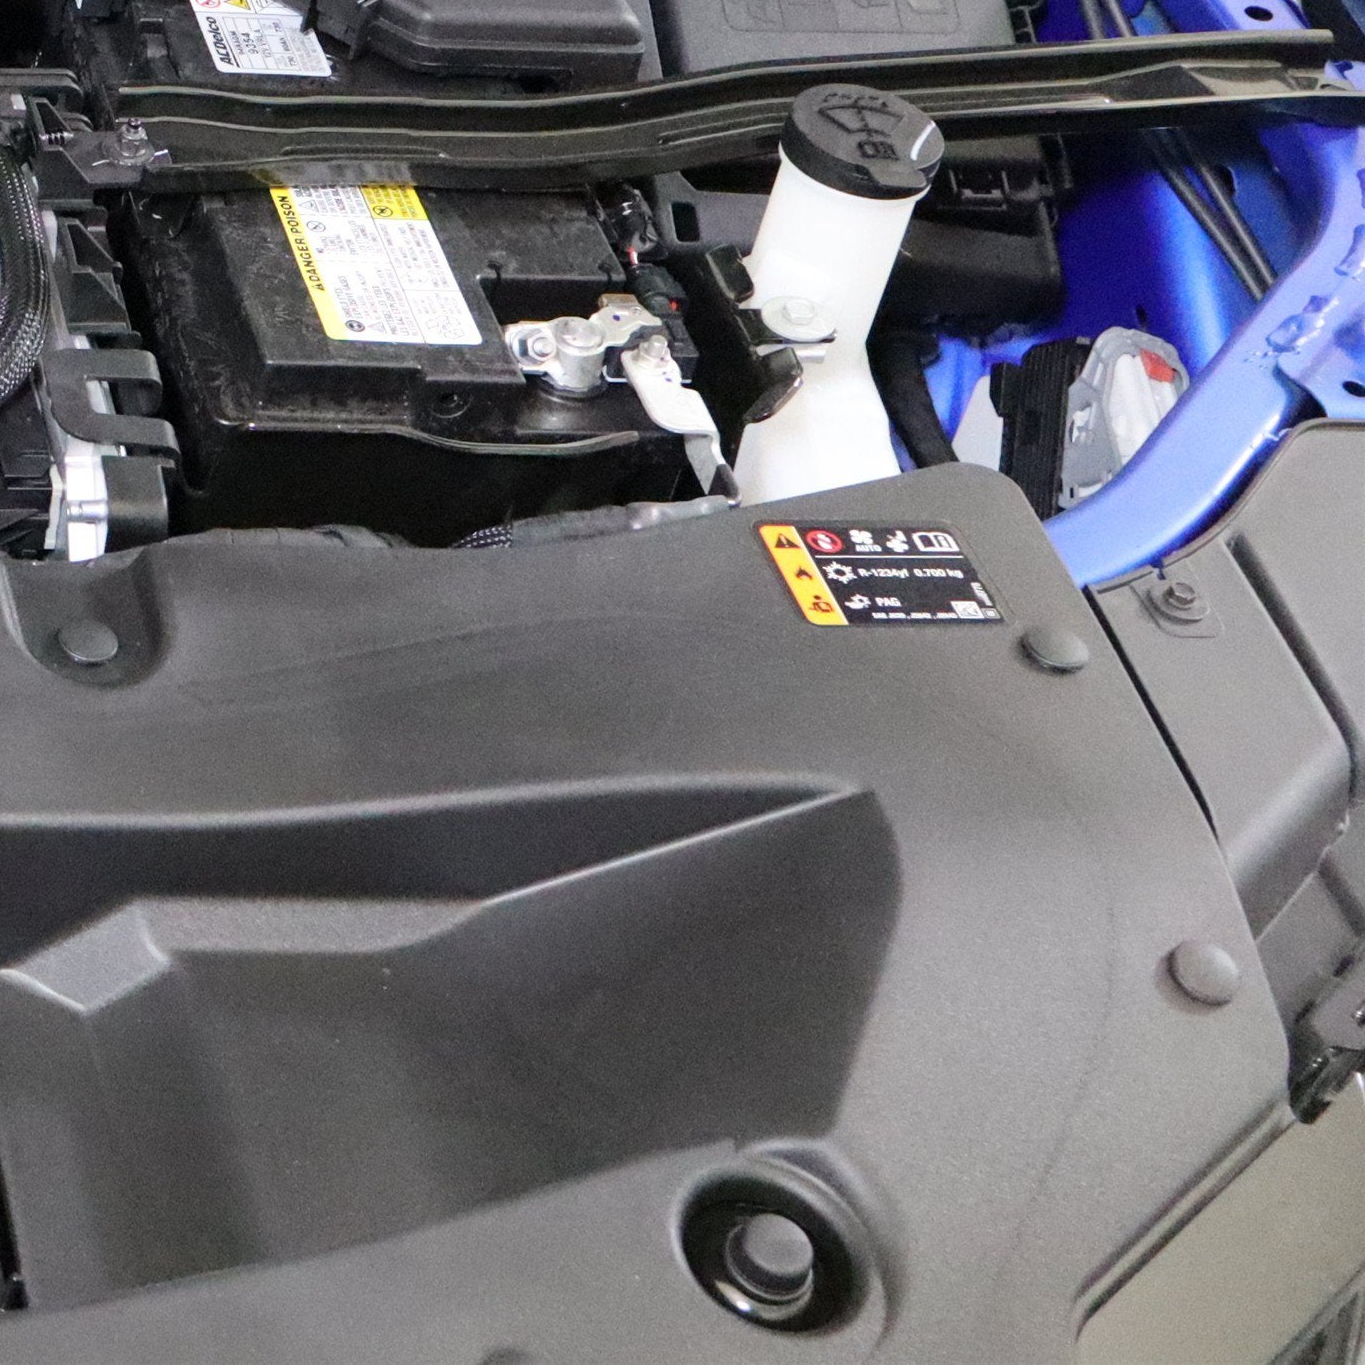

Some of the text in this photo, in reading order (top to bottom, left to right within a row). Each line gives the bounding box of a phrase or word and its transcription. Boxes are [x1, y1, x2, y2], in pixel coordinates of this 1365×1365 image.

[206, 16, 234, 65] ACDelco
[241, 33, 259, 54] 9354
[278, 195, 321, 282] DANGER POISON
[855, 544, 883, 553] AUTO
[857, 568, 964, 579] R-1234yf 0.700 kg
[875, 597, 902, 607] PAG
